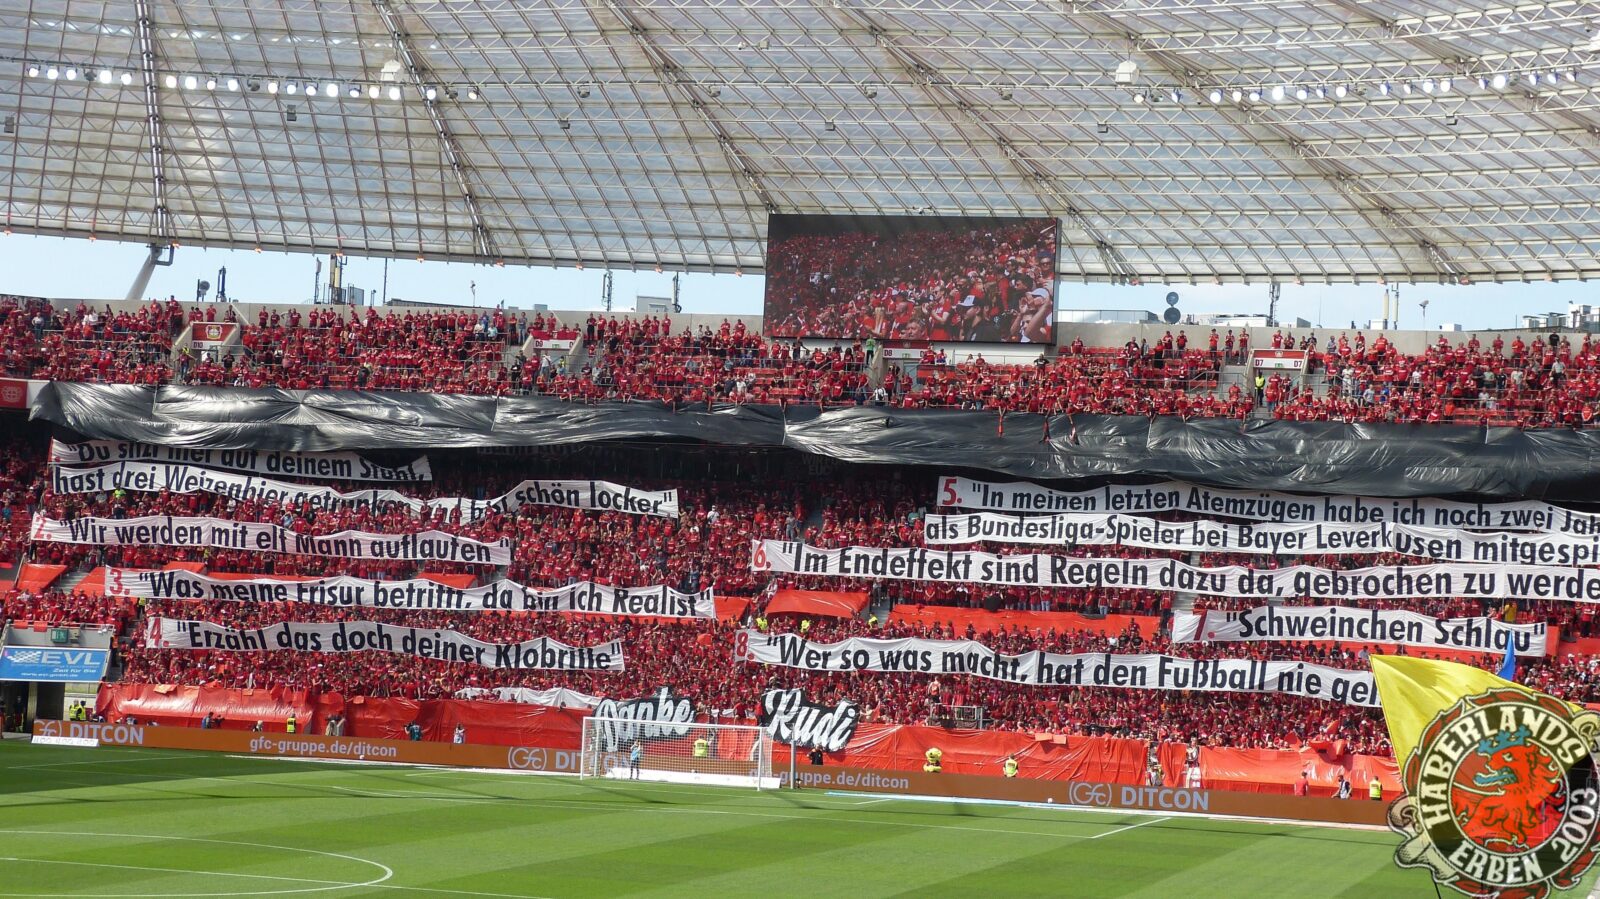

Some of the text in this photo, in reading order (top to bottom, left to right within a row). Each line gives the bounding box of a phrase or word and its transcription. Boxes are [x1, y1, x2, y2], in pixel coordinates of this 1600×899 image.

[267, 450, 352, 477] deinem
[55, 464, 105, 493] hast
[112, 460, 157, 489] drei
[165, 465, 288, 504] Weizenbier
[515, 481, 580, 506] schön
[590, 481, 672, 514] locker"
[943, 478, 1600, 535] 5. "In meinen letzten Atemzügen habe ich noch zwei Jah
[34, 514, 53, 540] 2.
[60, 517, 107, 543] "Wir
[115, 516, 201, 545] werden
[212, 522, 248, 549] mit
[256, 525, 287, 553] elf
[295, 533, 362, 557] Mann
[927, 511, 1600, 568] als Bundesliga-Spieler bei Bayer Leverkusen mitgespi
[753, 540, 1600, 600] 6. "Im Endeffekt sind Regeln dazu da, gebrochen zu werde
[110, 571, 131, 596] 3.
[140, 571, 204, 599] "Was
[211, 583, 287, 601] meine
[483, 583, 513, 609] da
[570, 582, 603, 612] ich
[613, 585, 711, 617] Realist"
[149, 617, 170, 648] 4.
[177, 621, 268, 650] "Erzähl
[276, 622, 321, 650] das
[332, 622, 393, 651] doch
[402, 628, 485, 665] deiner
[1226, 606, 1423, 643] "Schweinchen
[1434, 617, 1545, 652] Schlau"
[41, 651, 101, 665] EVL
[737, 632, 1381, 706] 8. "Wer so was macht, hat den Fußball nie gel
[70, 723, 144, 745] DITCON
[763, 687, 857, 752] Rudi
[250, 735, 397, 758] gfc-gruppe.de/ditcon
[1121, 786, 1209, 811] DITCON
